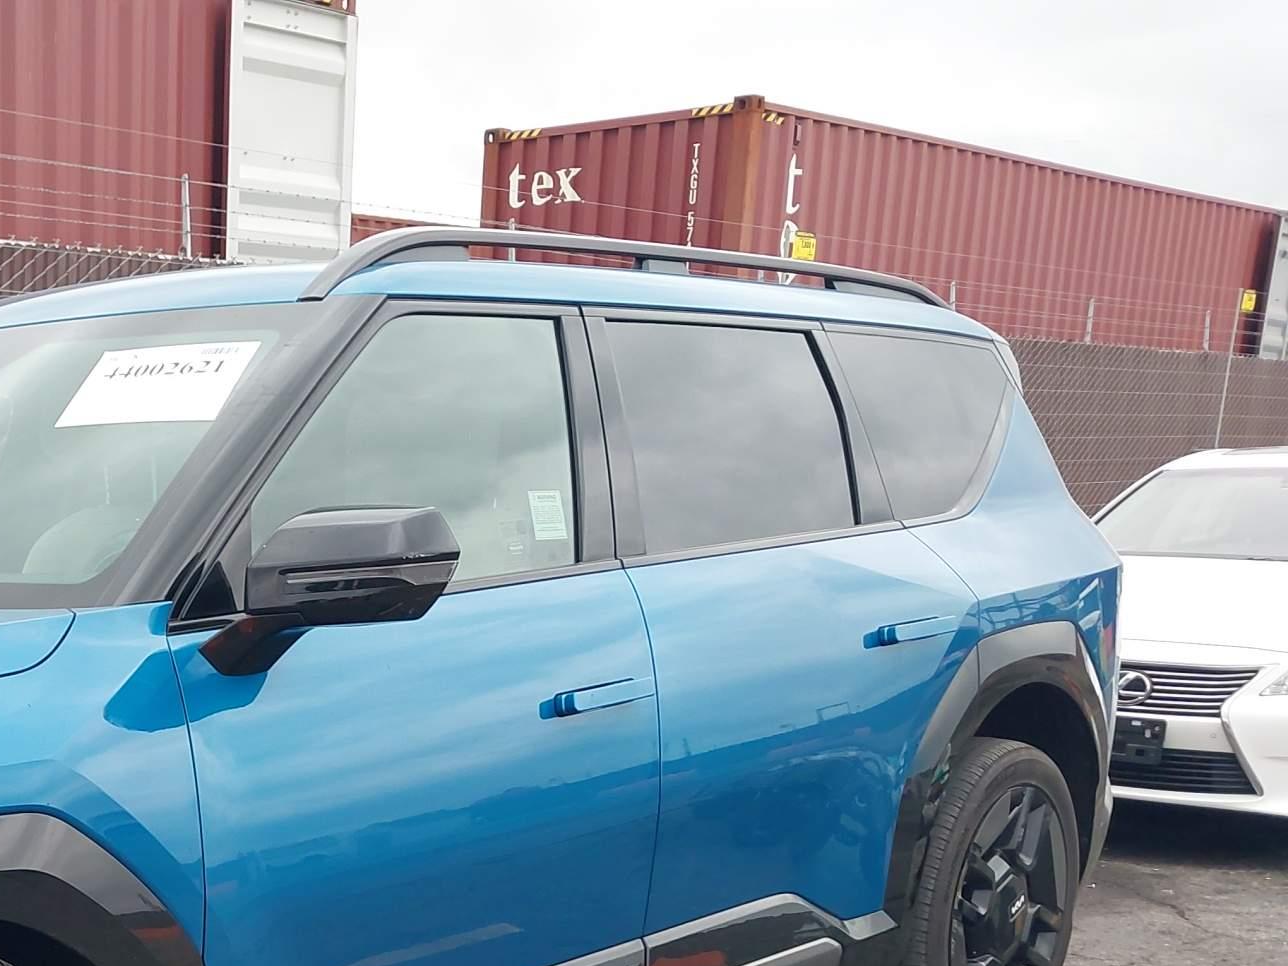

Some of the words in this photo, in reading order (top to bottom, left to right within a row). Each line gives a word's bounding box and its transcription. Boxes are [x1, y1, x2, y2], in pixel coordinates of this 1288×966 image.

[508, 162, 583, 209] tex
[688, 143, 701, 205] TXGU
[686, 211, 695, 247] 57
[104, 359, 225, 379] 44002621
